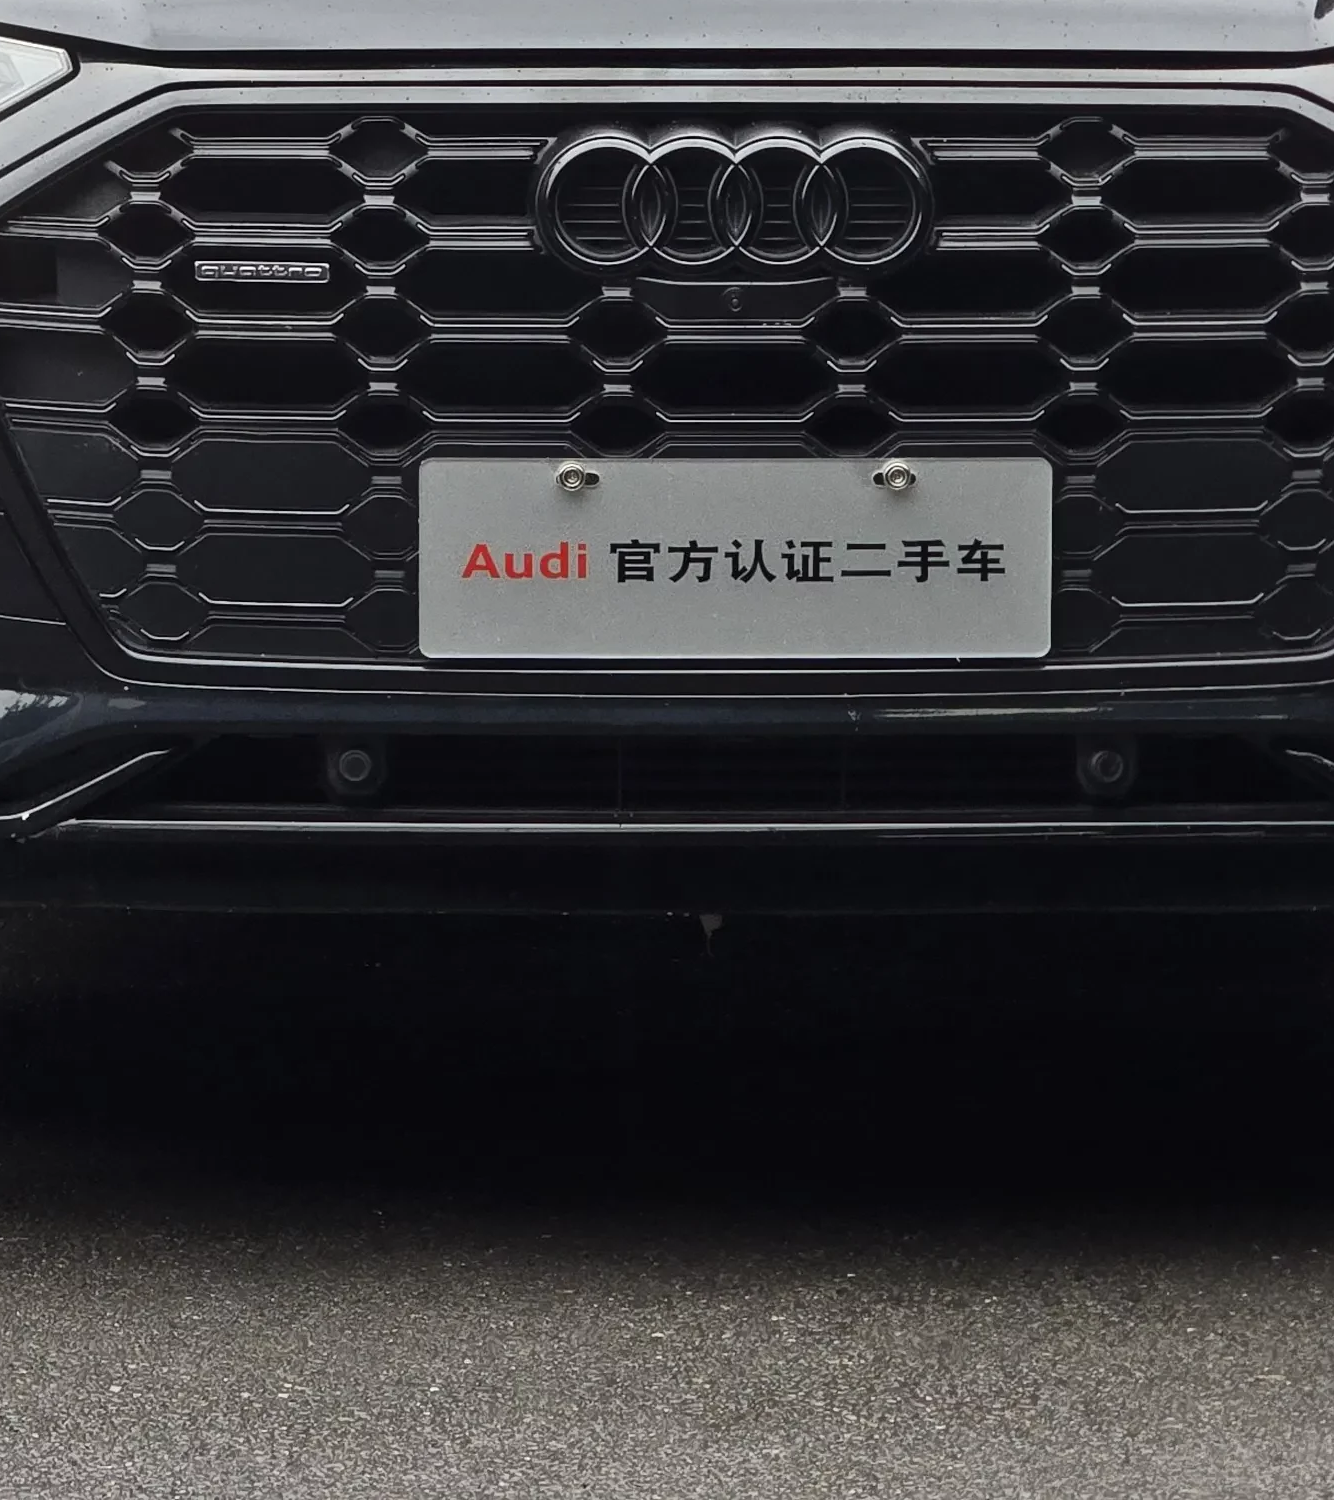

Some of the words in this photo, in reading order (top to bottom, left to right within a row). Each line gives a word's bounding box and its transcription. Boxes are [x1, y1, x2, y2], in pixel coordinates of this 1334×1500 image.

[461, 542, 589, 580] Audi
[610, 539, 1007, 583] 官方认证二手车
